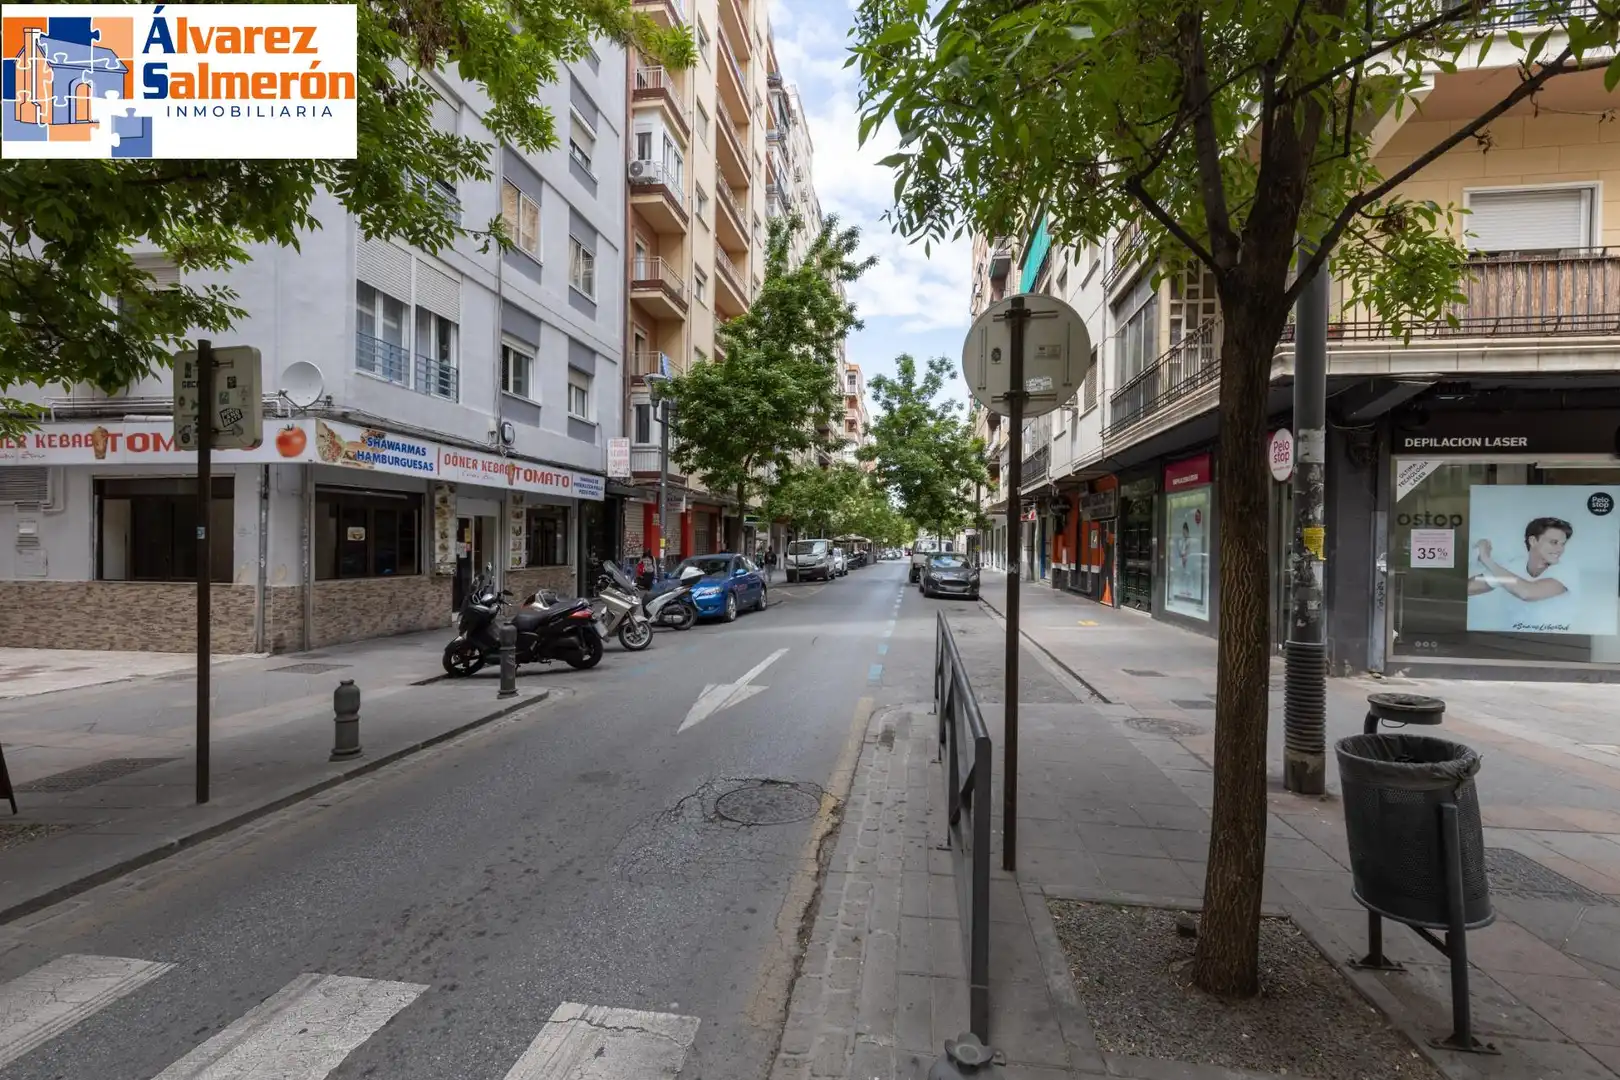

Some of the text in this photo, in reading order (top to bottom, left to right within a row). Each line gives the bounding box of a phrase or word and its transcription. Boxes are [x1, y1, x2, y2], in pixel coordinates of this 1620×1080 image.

[36, 434, 94, 449] KEBAB
[367, 437, 426, 456] SHAWARMAS
[1273, 440, 1290, 453] Pelo
[357, 450, 434, 471] HAMBURGUESAS
[1273, 451, 1290, 463] stop
[444, 452, 478, 470] DÖNER
[512, 466, 570, 488] TOMATO
